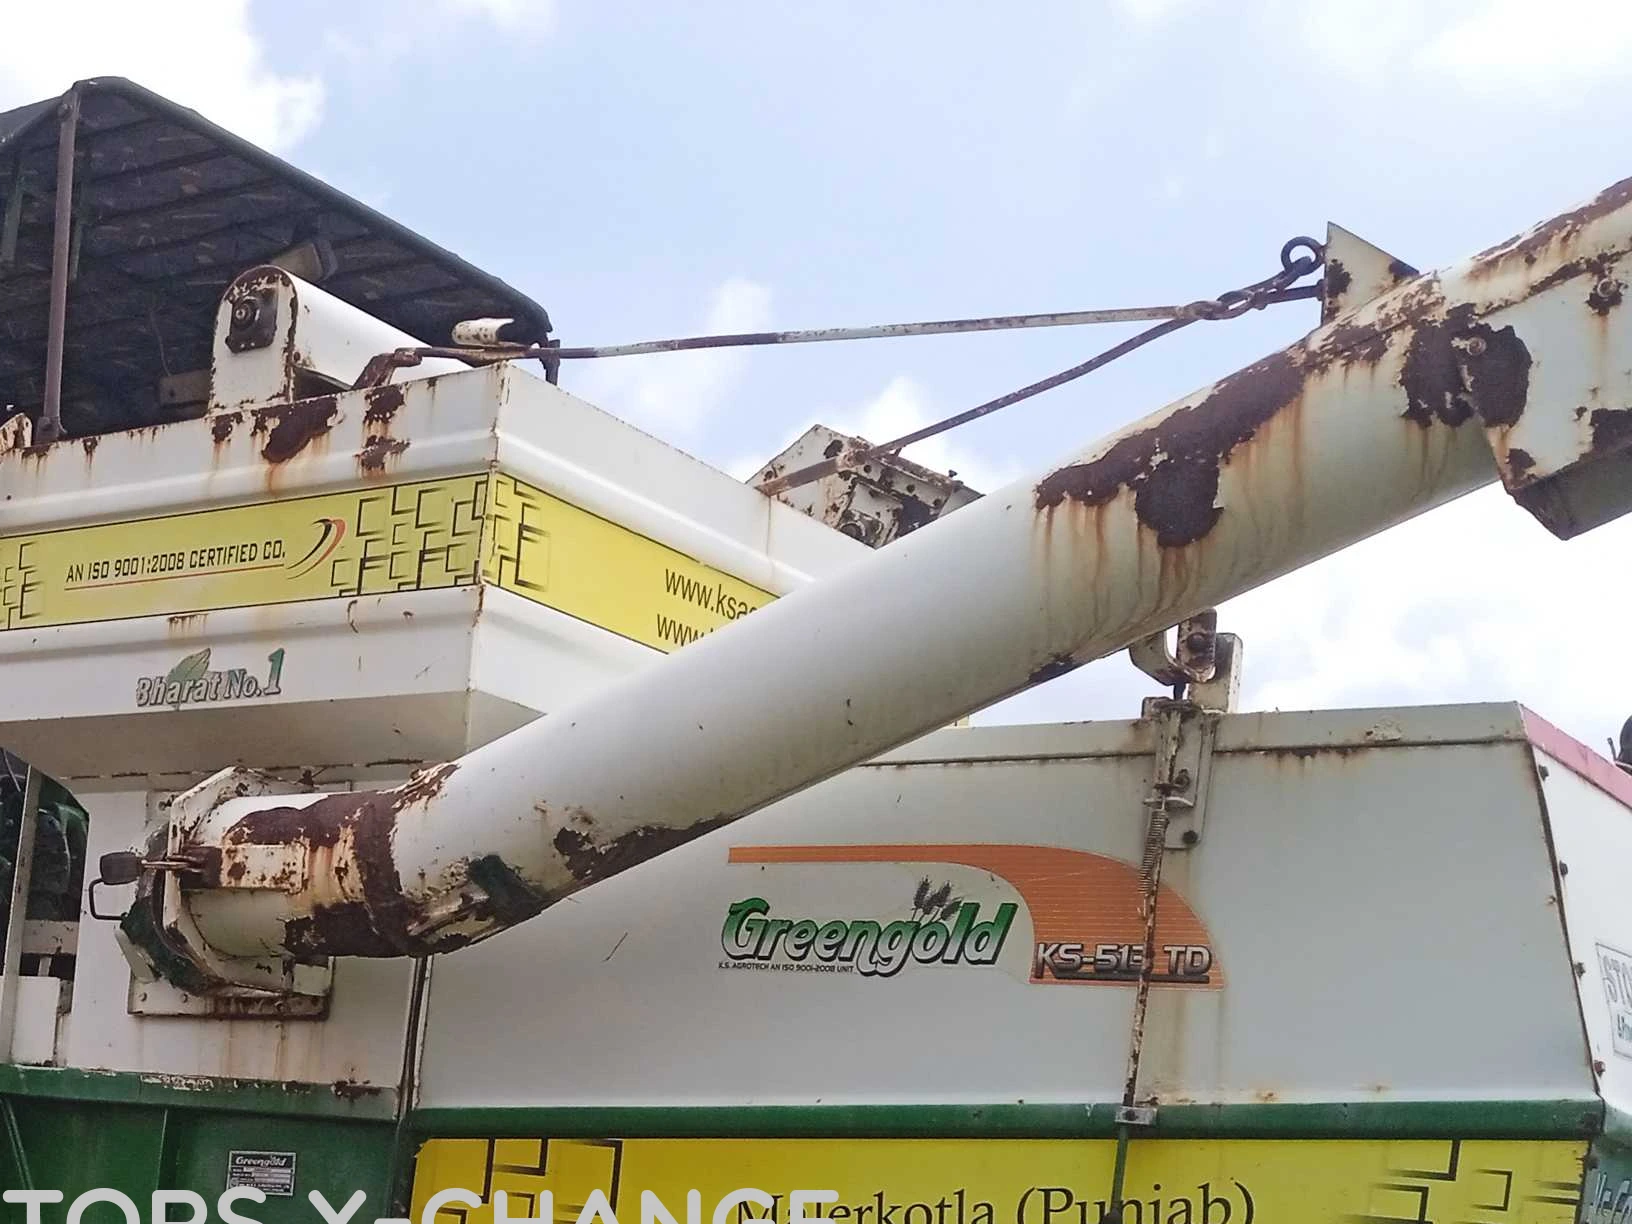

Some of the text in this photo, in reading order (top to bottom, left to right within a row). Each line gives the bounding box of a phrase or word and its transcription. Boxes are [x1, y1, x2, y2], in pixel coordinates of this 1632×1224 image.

[66, 539, 286, 583] AN ISO 9001:2008 CERTIFIED CO.
[665, 568, 758, 621] www.ksa
[135, 670, 222, 708] Bharat
[721, 897, 1019, 978] Greengold
[1162, 944, 1213, 977] TD
[235, 1154, 287, 1167] Greengold
